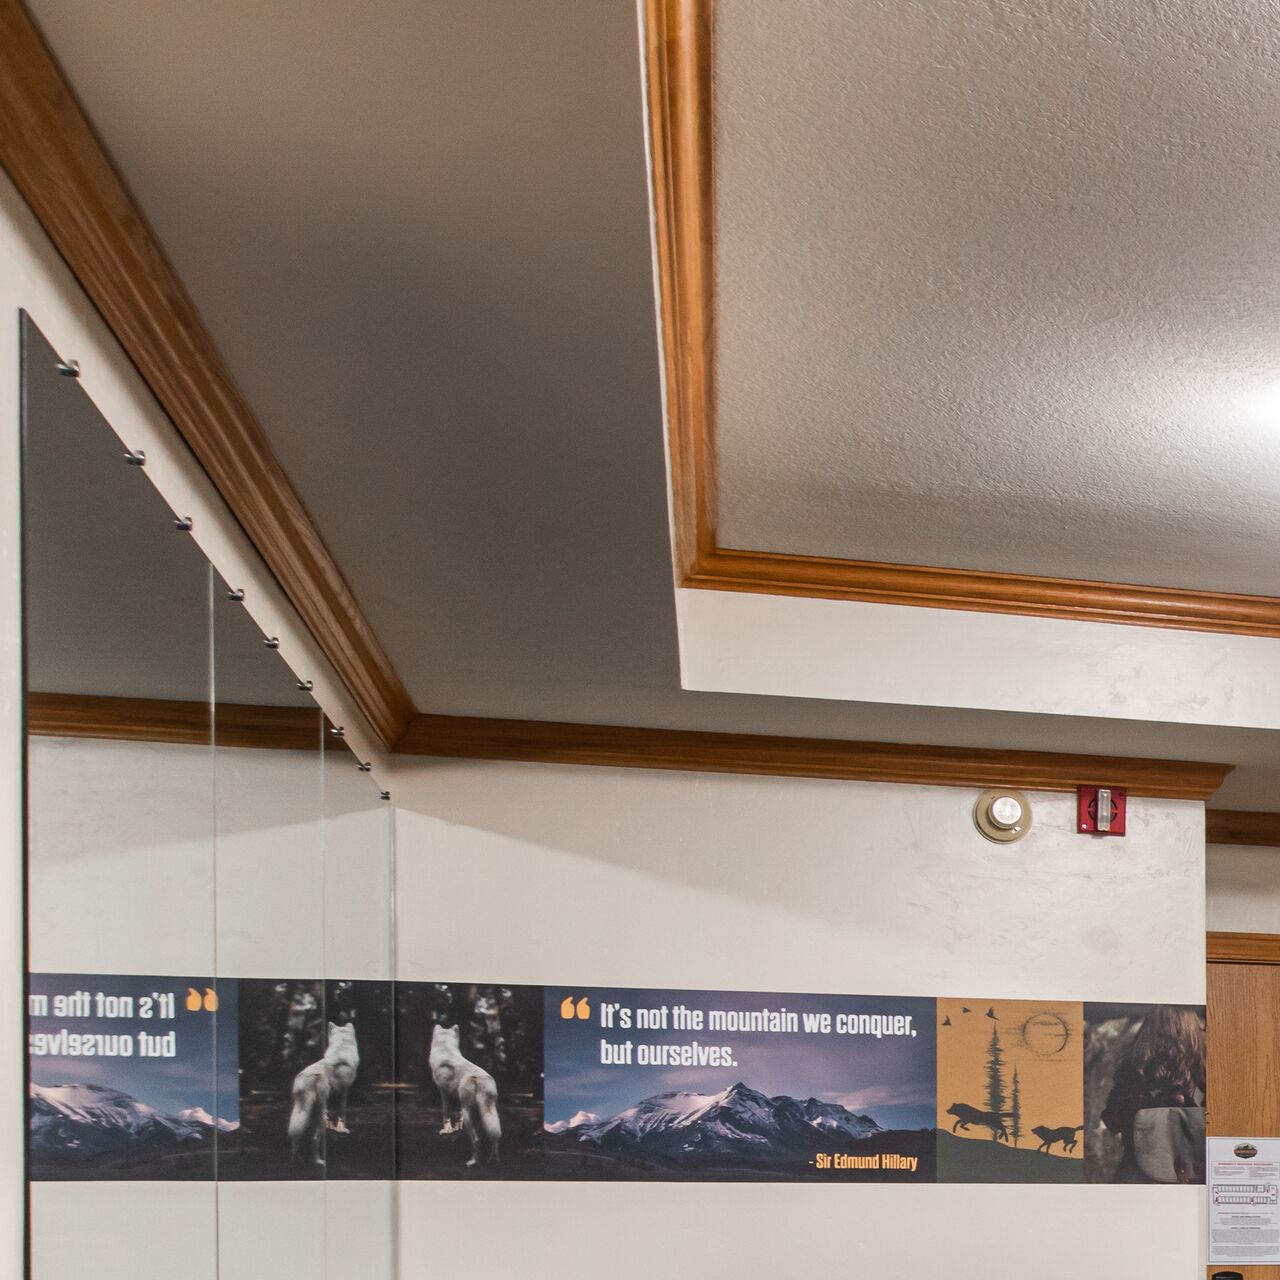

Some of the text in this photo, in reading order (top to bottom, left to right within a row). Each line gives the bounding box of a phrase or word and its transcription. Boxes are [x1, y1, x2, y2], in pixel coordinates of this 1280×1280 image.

[636, 1005, 668, 1030] not
[672, 1005, 704, 1030] the
[708, 1008, 798, 1033] mountain
[802, 1012, 832, 1034] we
[836, 1013, 917, 1039] conquer,
[601, 1039, 738, 1067] but ourselves.
[816, 1153, 832, 1169] Sir
[834, 1153, 880, 1169] Edmund
[882, 1153, 918, 1172] Hillary
